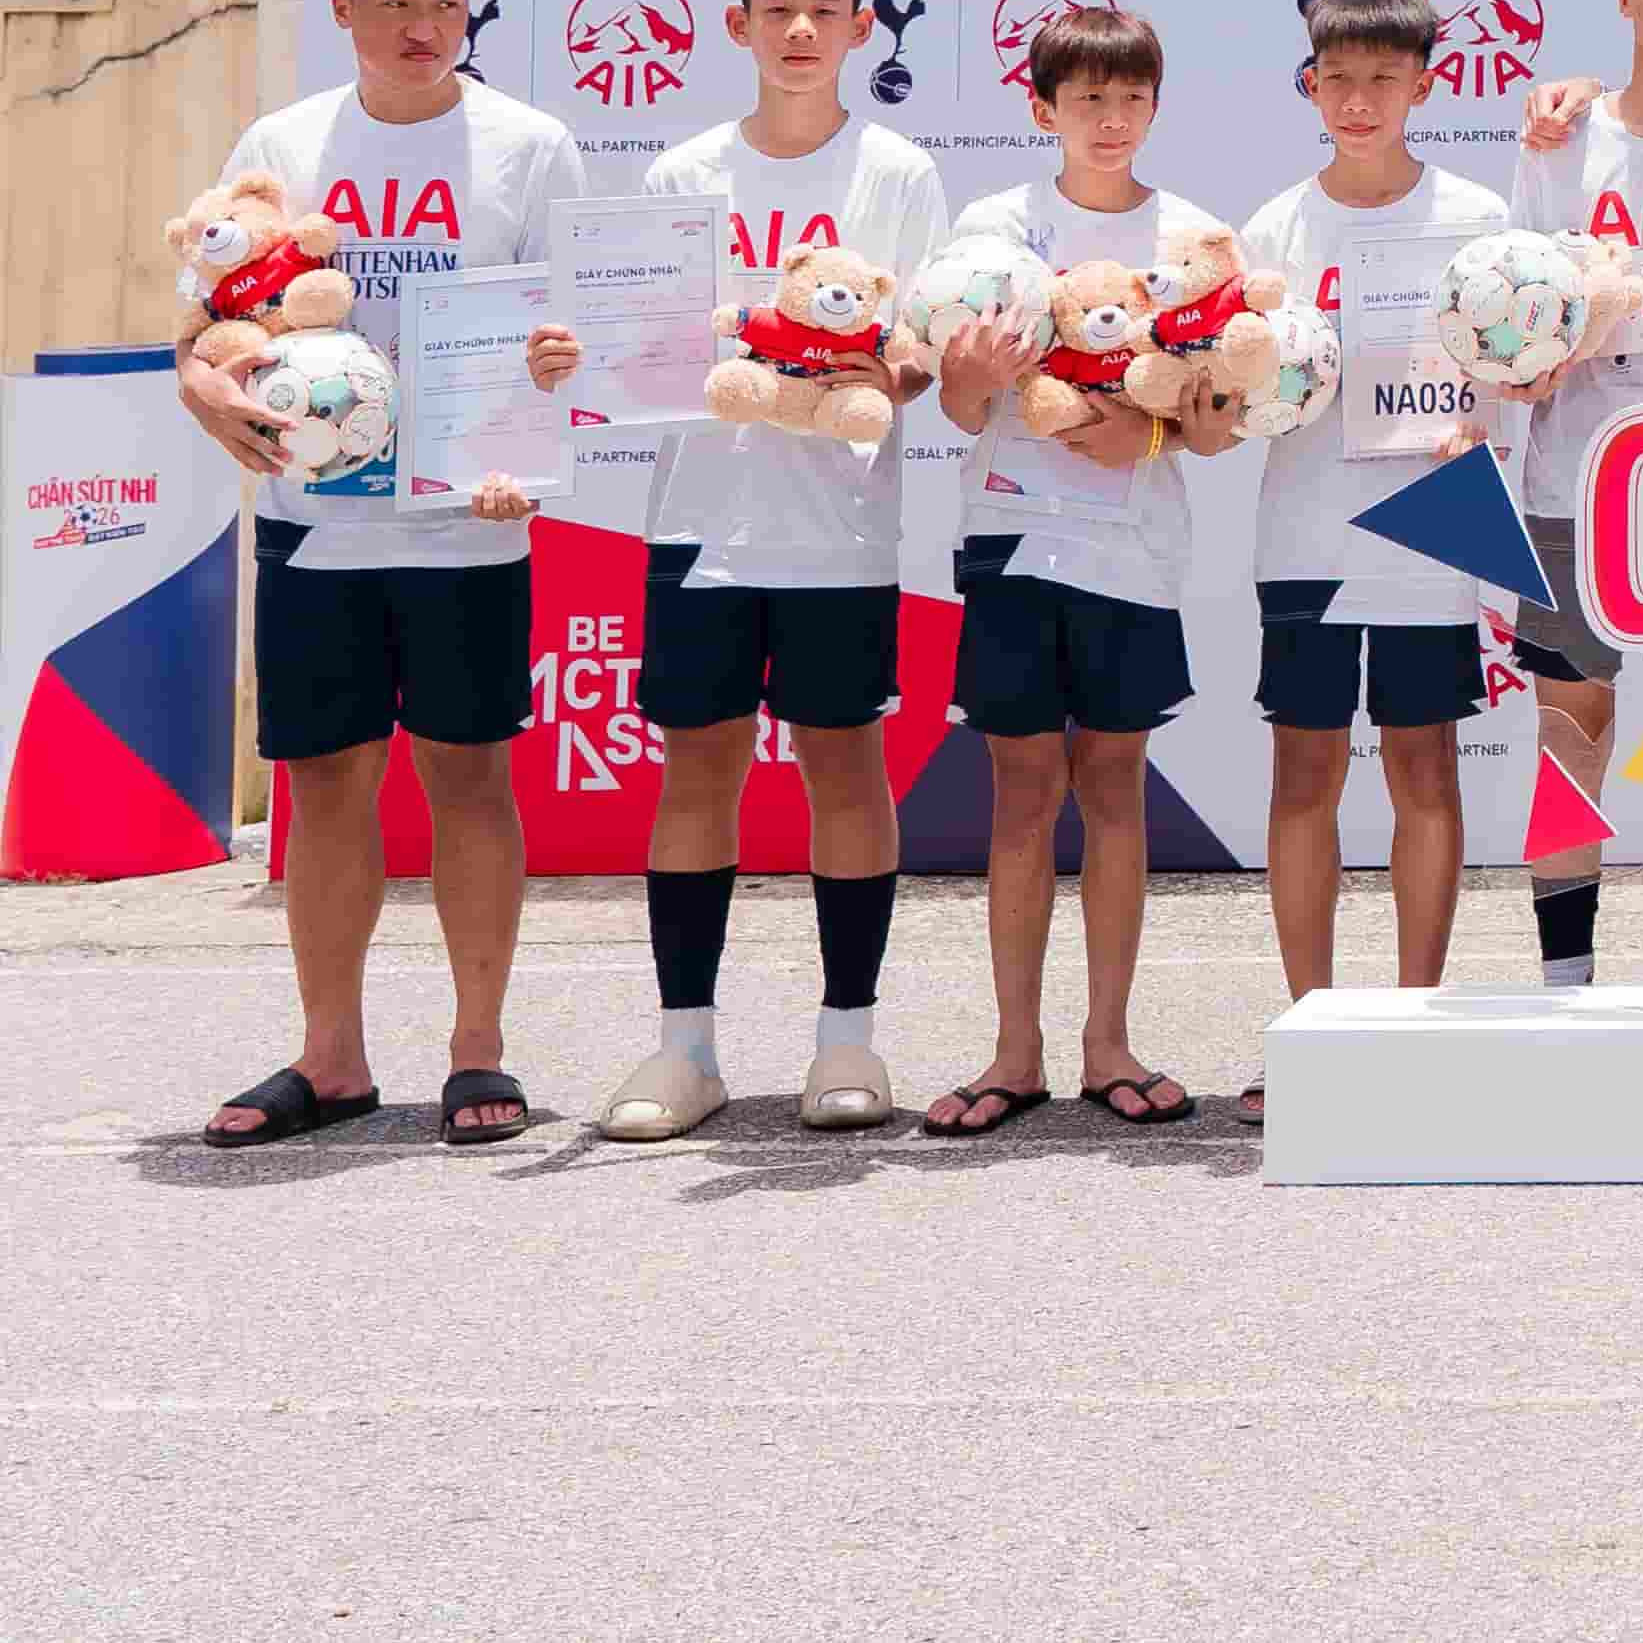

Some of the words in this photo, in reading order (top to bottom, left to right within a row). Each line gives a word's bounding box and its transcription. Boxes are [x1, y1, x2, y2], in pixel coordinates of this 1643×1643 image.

[1433, 51, 1535, 98] AIA
[575, 61, 685, 108] AIA
[913, 135, 950, 148] OBAL
[952, 135, 1026, 149] PRINCIPAL
[1029, 134, 1062, 147] PART
[1453, 130, 1517, 143] PARTNER
[602, 140, 666, 152] PARTNER
[321, 178, 461, 240] AIA
[229, 274, 258, 298] AIA
[1175, 310, 1202, 327] AIA
[1101, 351, 1131, 366] AIA
[1374, 380, 1476, 415] NA036
[592, 450, 657, 464] PARTNER
[904, 447, 943, 460] OBAL
[567, 615, 625, 652] BE
